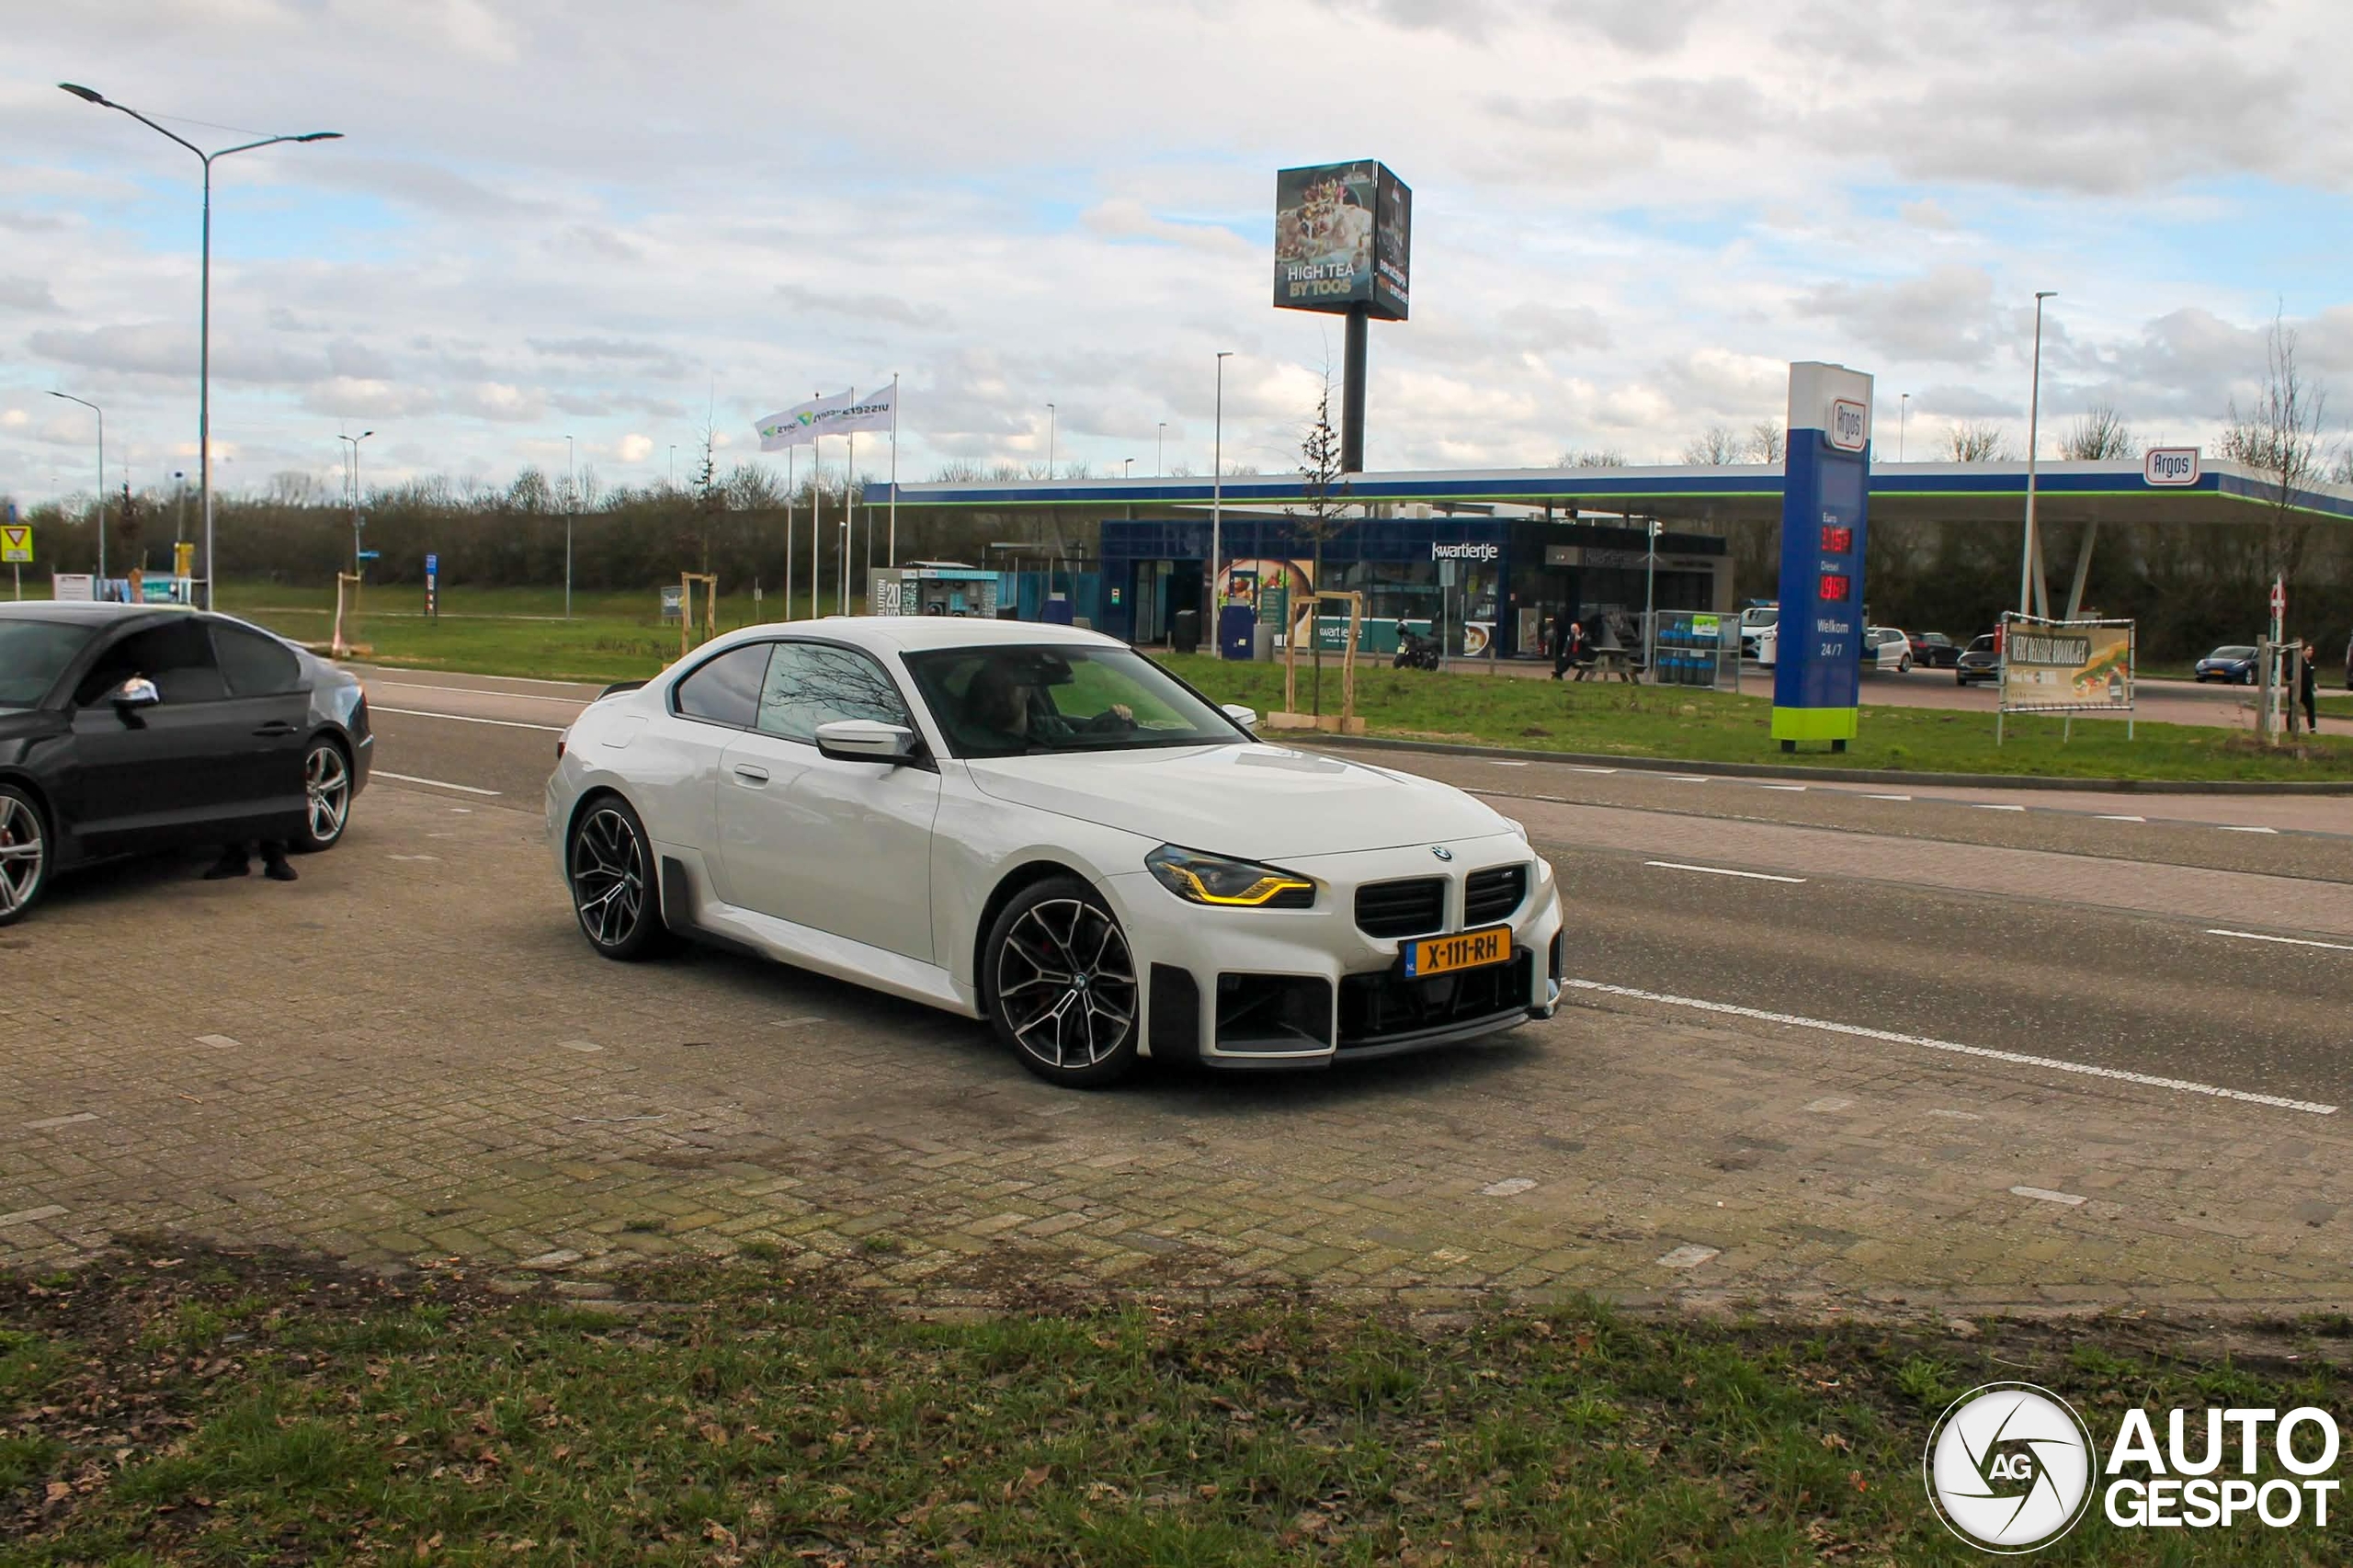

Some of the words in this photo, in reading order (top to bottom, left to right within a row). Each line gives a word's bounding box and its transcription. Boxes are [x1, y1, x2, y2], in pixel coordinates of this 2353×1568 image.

[1288, 265, 1324, 281] HIGH
[1327, 263, 1355, 278] TEA
[1290, 282, 1307, 298] BY
[1837, 405, 1860, 440] Argos
[2154, 454, 2188, 478] Argos
[1823, 512, 1836, 523] Euro
[1432, 542, 1498, 562] kwartiertje
[1820, 560, 1839, 571] Diesel
[1817, 619, 1848, 634] Welkom
[1821, 643, 1842, 656] 24/7
[1428, 935, 1497, 969] X-111-RH
